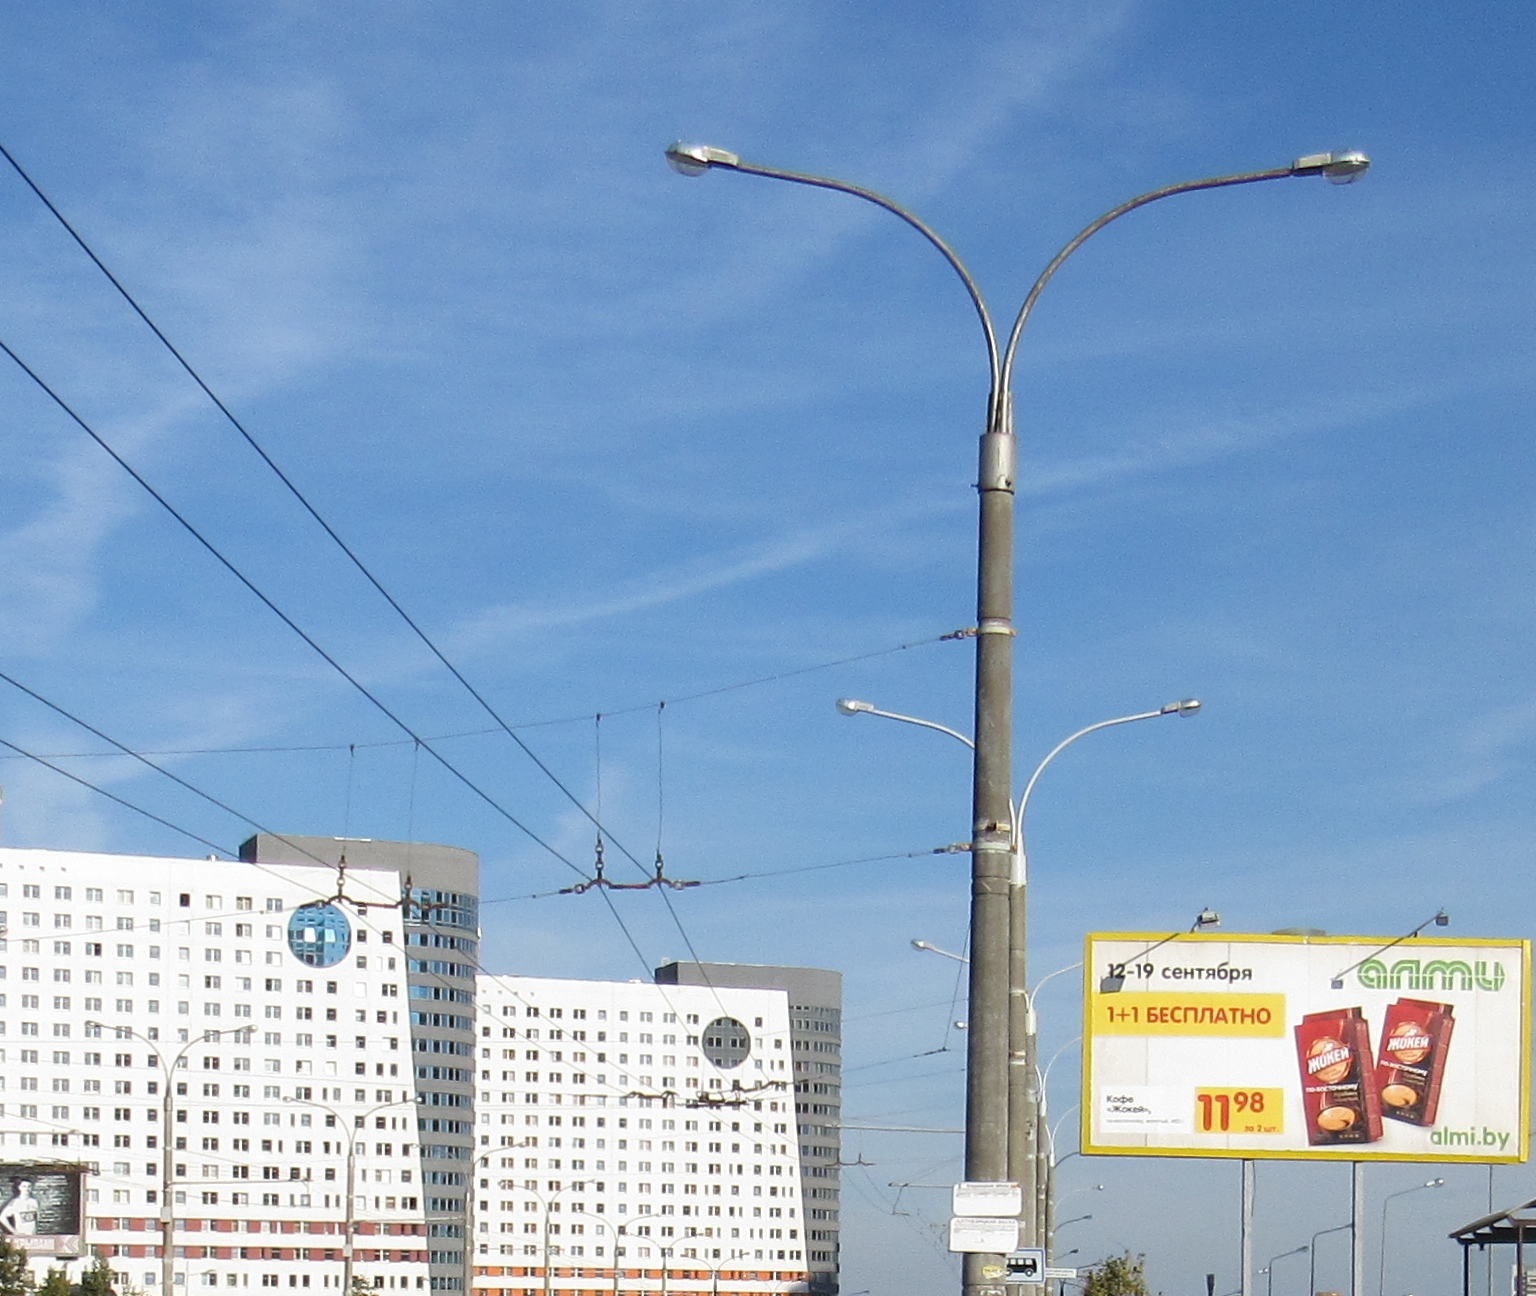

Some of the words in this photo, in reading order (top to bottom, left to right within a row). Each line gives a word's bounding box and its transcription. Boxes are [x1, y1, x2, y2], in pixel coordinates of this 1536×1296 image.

[1108, 963, 1154, 979] 12-19
[1161, 962, 1252, 984] сентября
[1107, 1006, 1139, 1023] 1+1
[1146, 1006, 1271, 1025] БЕСПЛАТНО
[1106, 1094, 1134, 1105] Кофе
[1197, 1094, 1230, 1132] 11
[1233, 1091, 1265, 1114] 98
[1257, 1124, 1263, 1132] 2
[1429, 1126, 1511, 1151] almi.by
